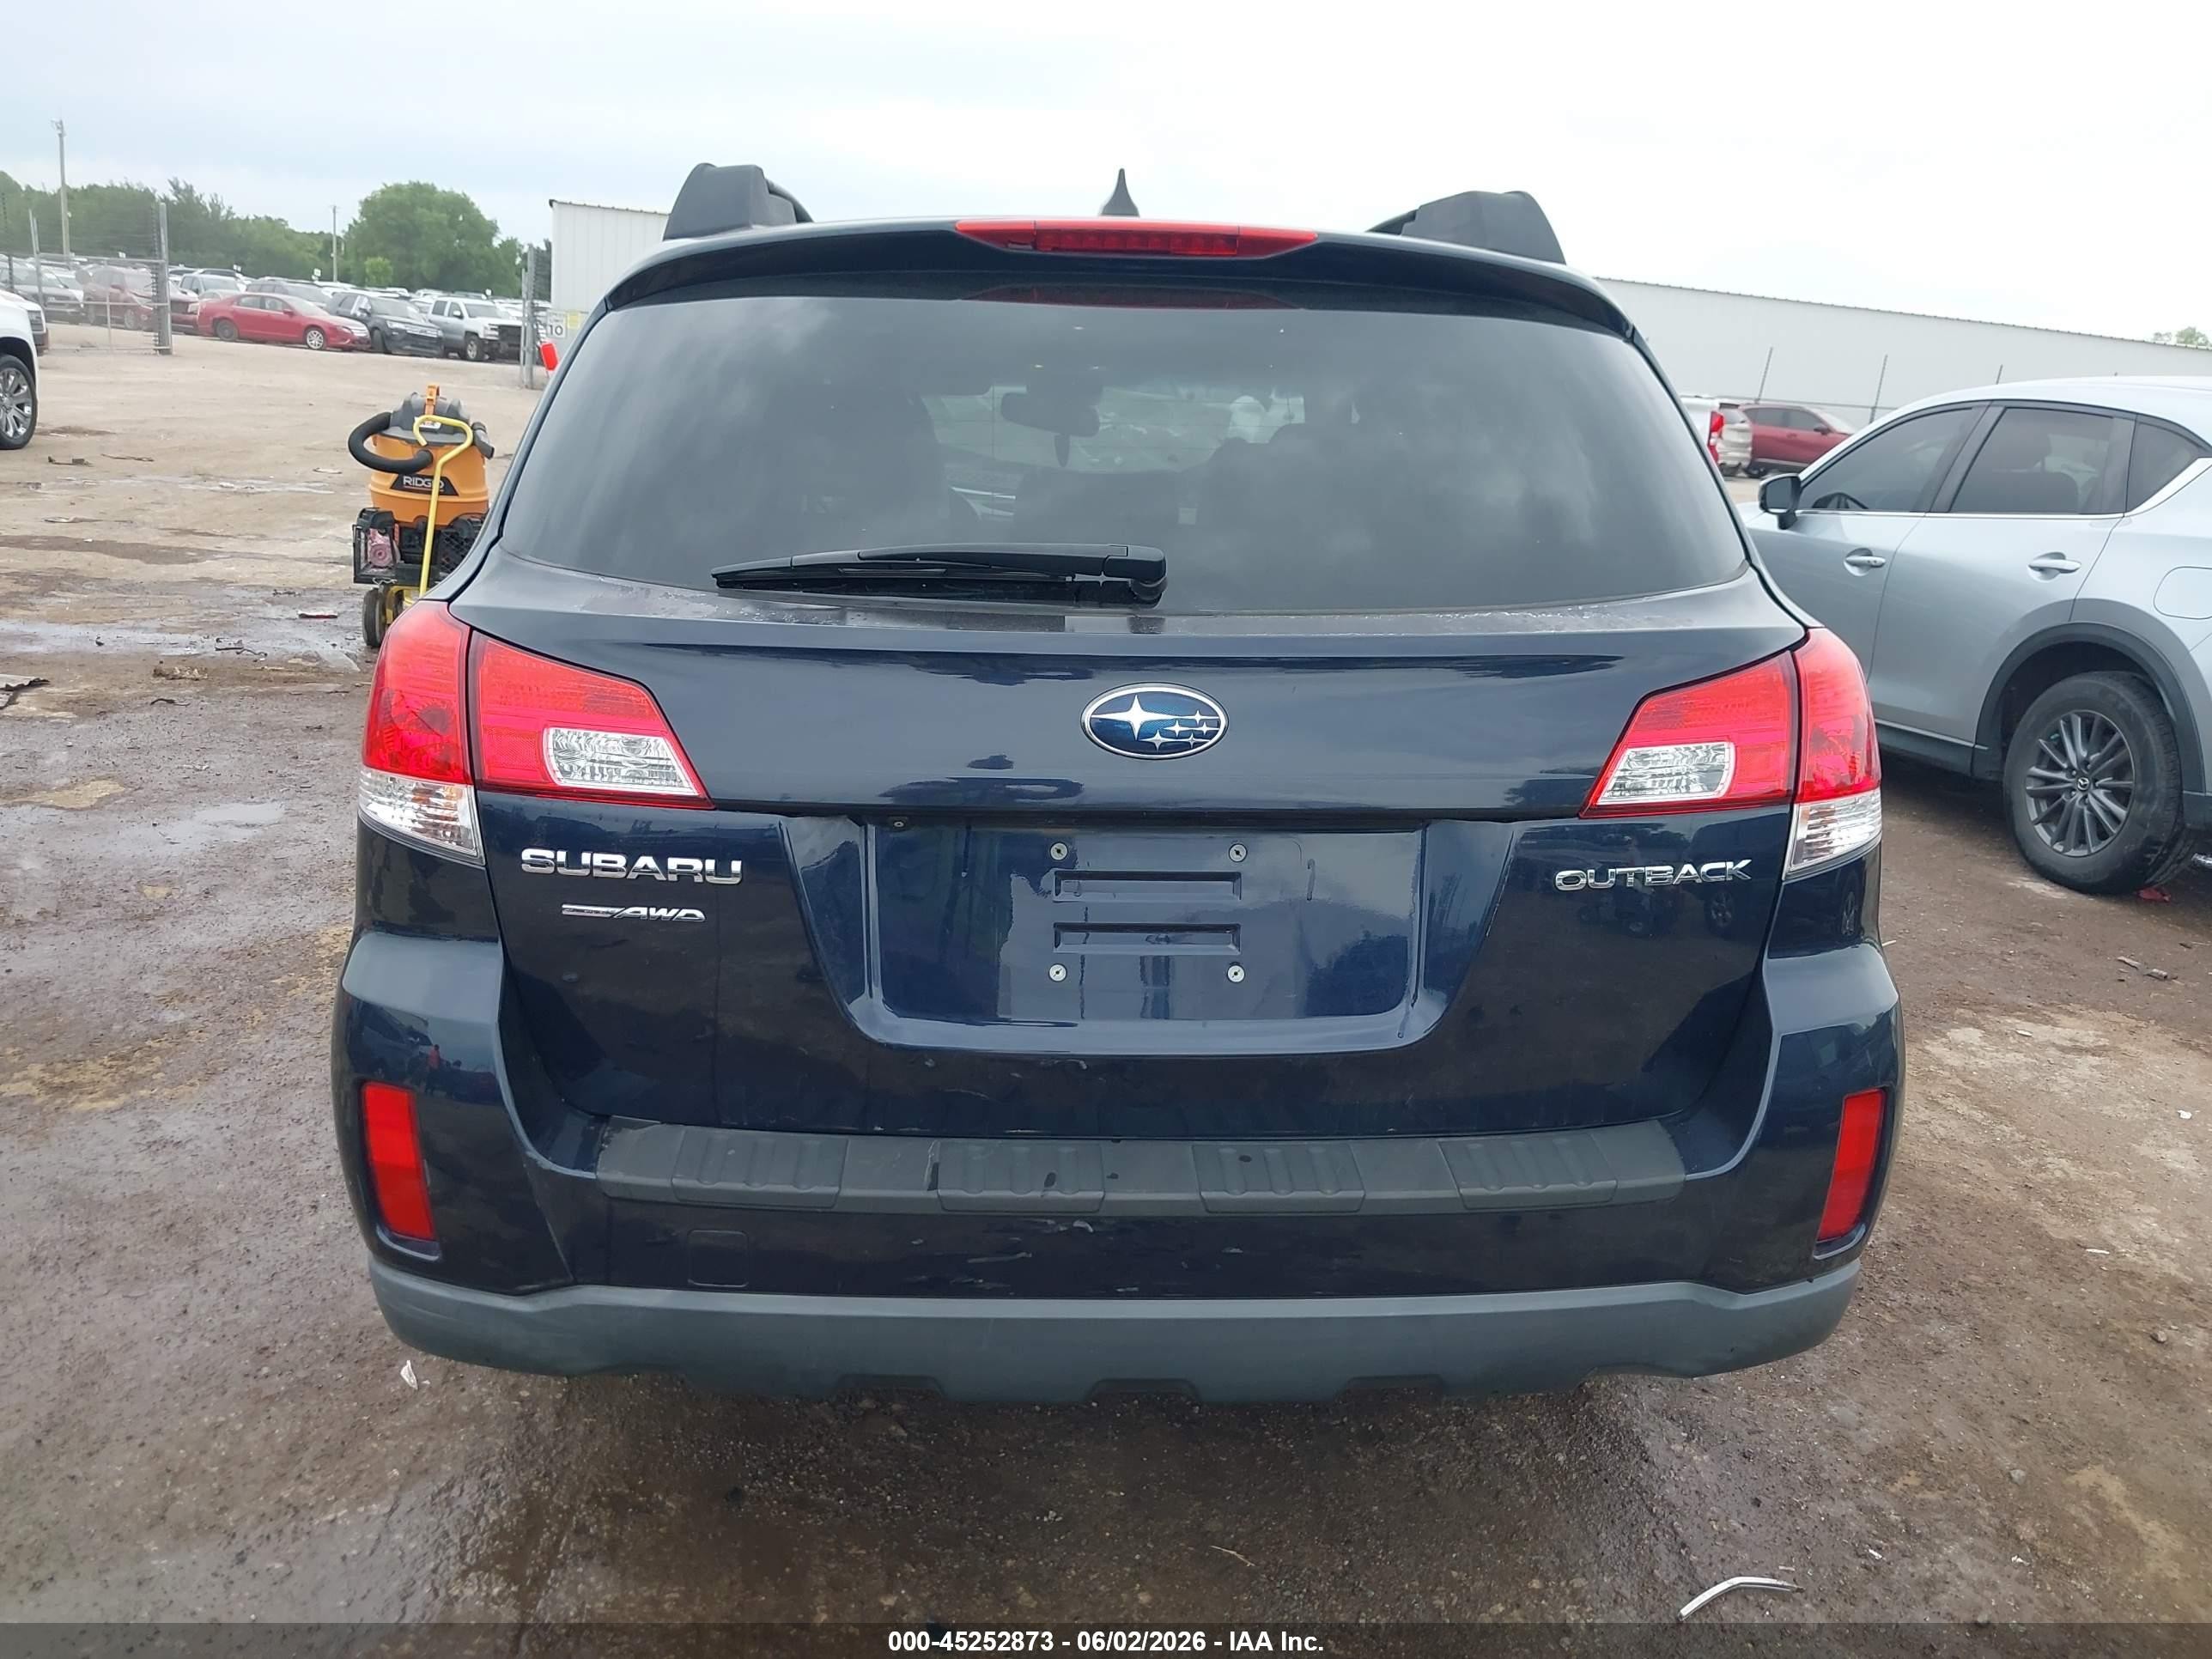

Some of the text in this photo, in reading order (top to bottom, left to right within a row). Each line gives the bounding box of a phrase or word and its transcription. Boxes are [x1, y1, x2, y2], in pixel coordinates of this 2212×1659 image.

[550, 325, 563, 336] 10
[403, 475, 445, 489] RIDGD
[521, 848, 742, 884] SUBARU
[1555, 859, 1752, 891] OUTBACK
[613, 907, 706, 922] AWD
